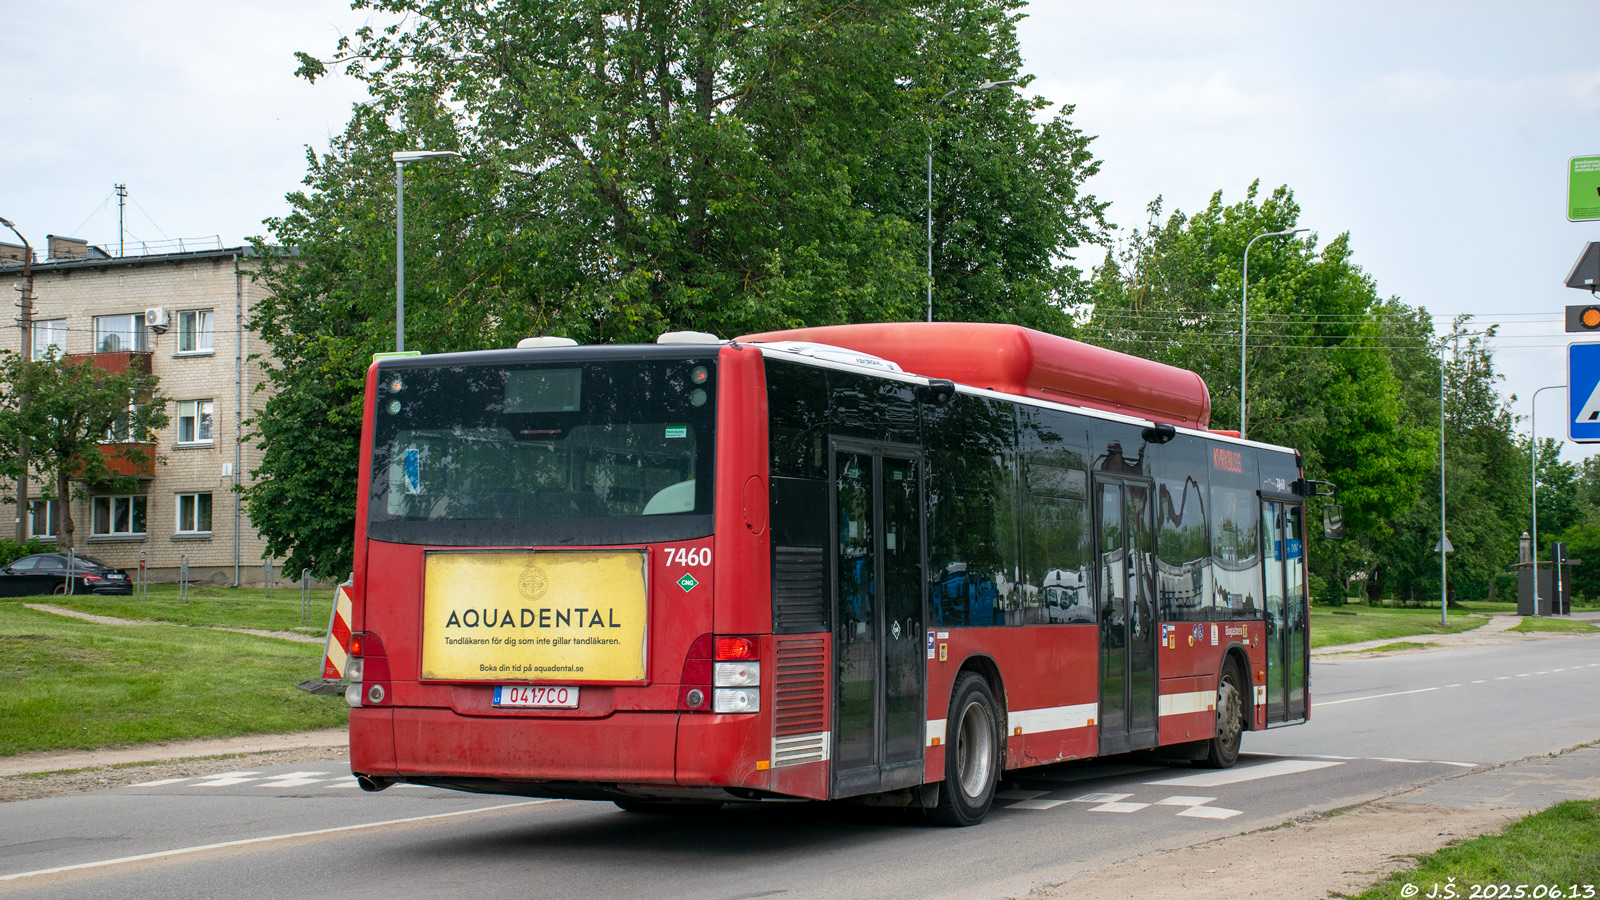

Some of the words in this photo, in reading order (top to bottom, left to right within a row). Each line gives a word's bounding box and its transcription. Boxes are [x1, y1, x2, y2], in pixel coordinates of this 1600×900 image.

[664, 547, 712, 567] 7460
[445, 608, 622, 628] AQUADENTAL
[444, 636, 490, 645] Tandläkaren
[491, 636, 503, 645] för
[504, 636, 517, 648] dig
[536, 636, 551, 645] inte
[552, 636, 572, 647] gillar
[573, 637, 621, 646] tandläkaren.
[479, 664, 498, 672] Boka
[498, 664, 511, 672] din
[511, 664, 522, 672] tid
[523, 664, 533, 673] på
[534, 664, 584, 673] aquadental.se
[510, 687, 569, 704] 0417CO
